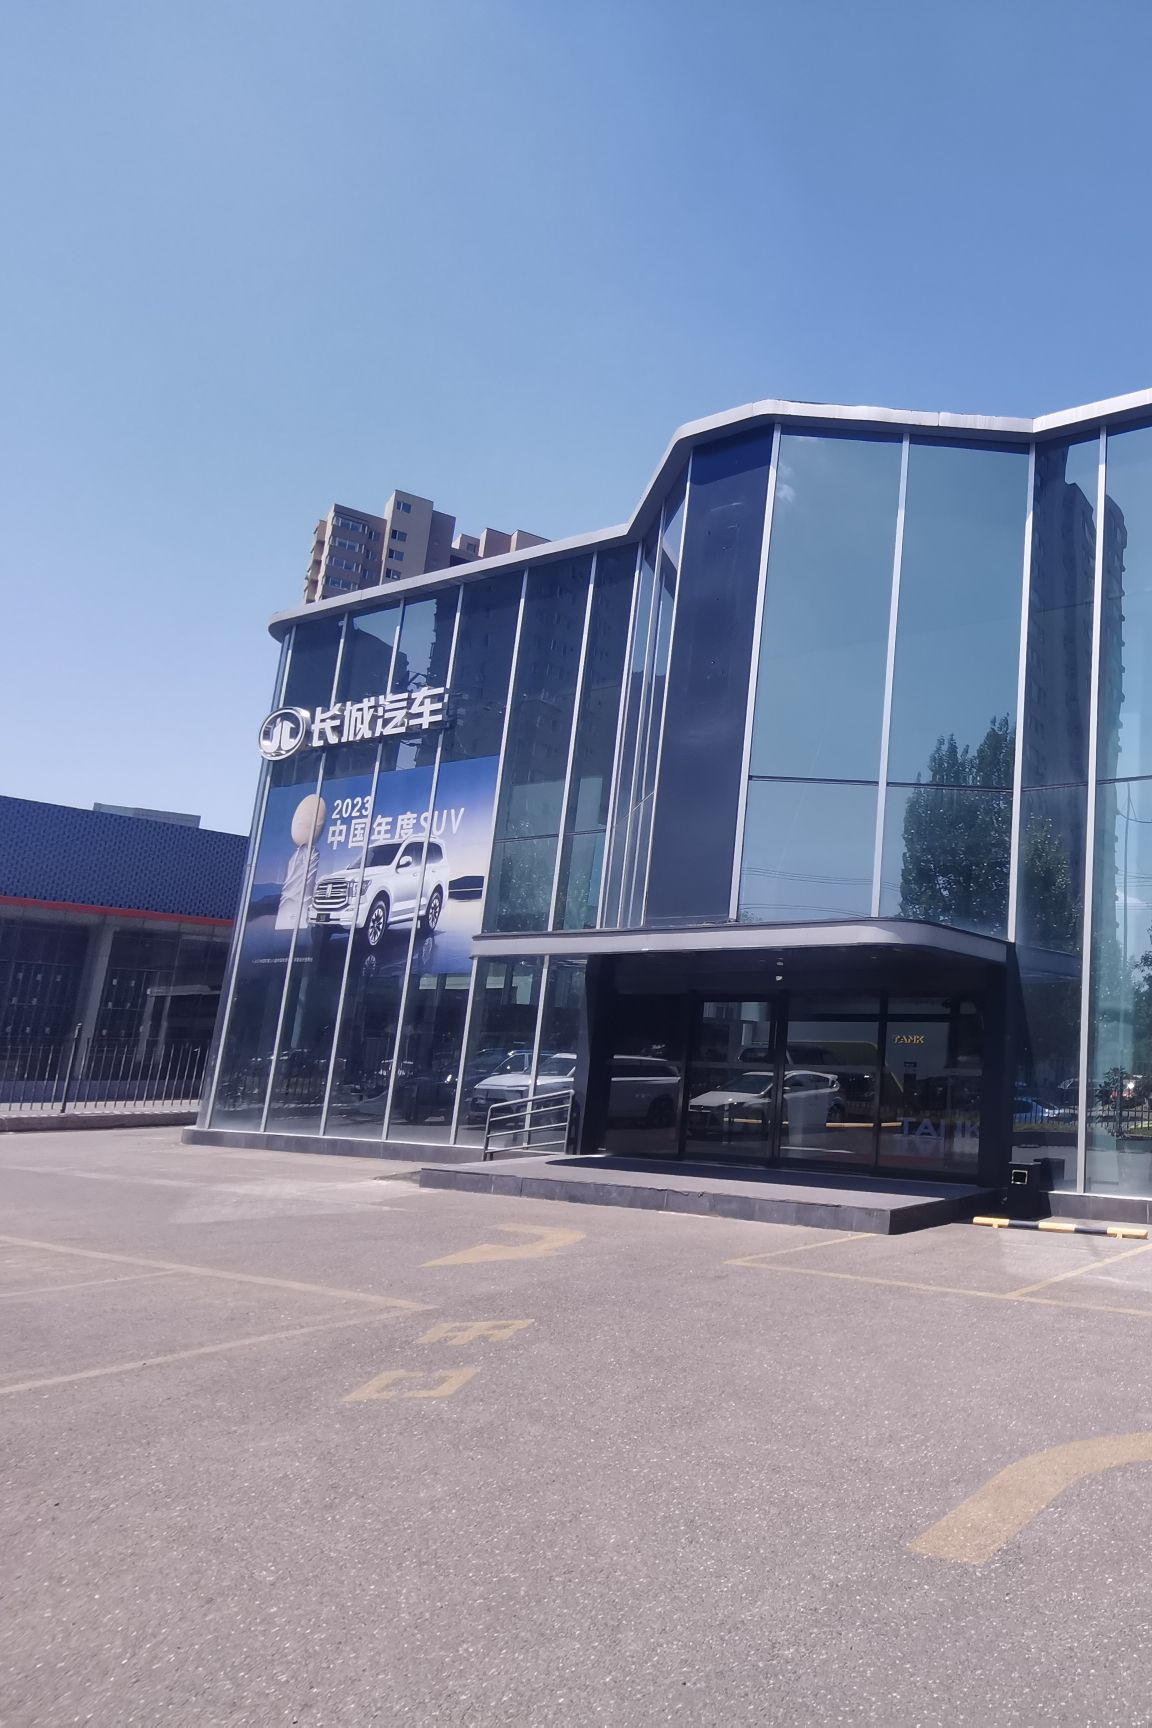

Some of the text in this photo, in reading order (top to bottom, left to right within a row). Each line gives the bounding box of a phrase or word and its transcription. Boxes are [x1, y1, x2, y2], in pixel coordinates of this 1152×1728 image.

[312, 687, 445, 747] 长城汽车
[331, 796, 373, 819] 2023
[327, 808, 465, 850] 中国年度SUV
